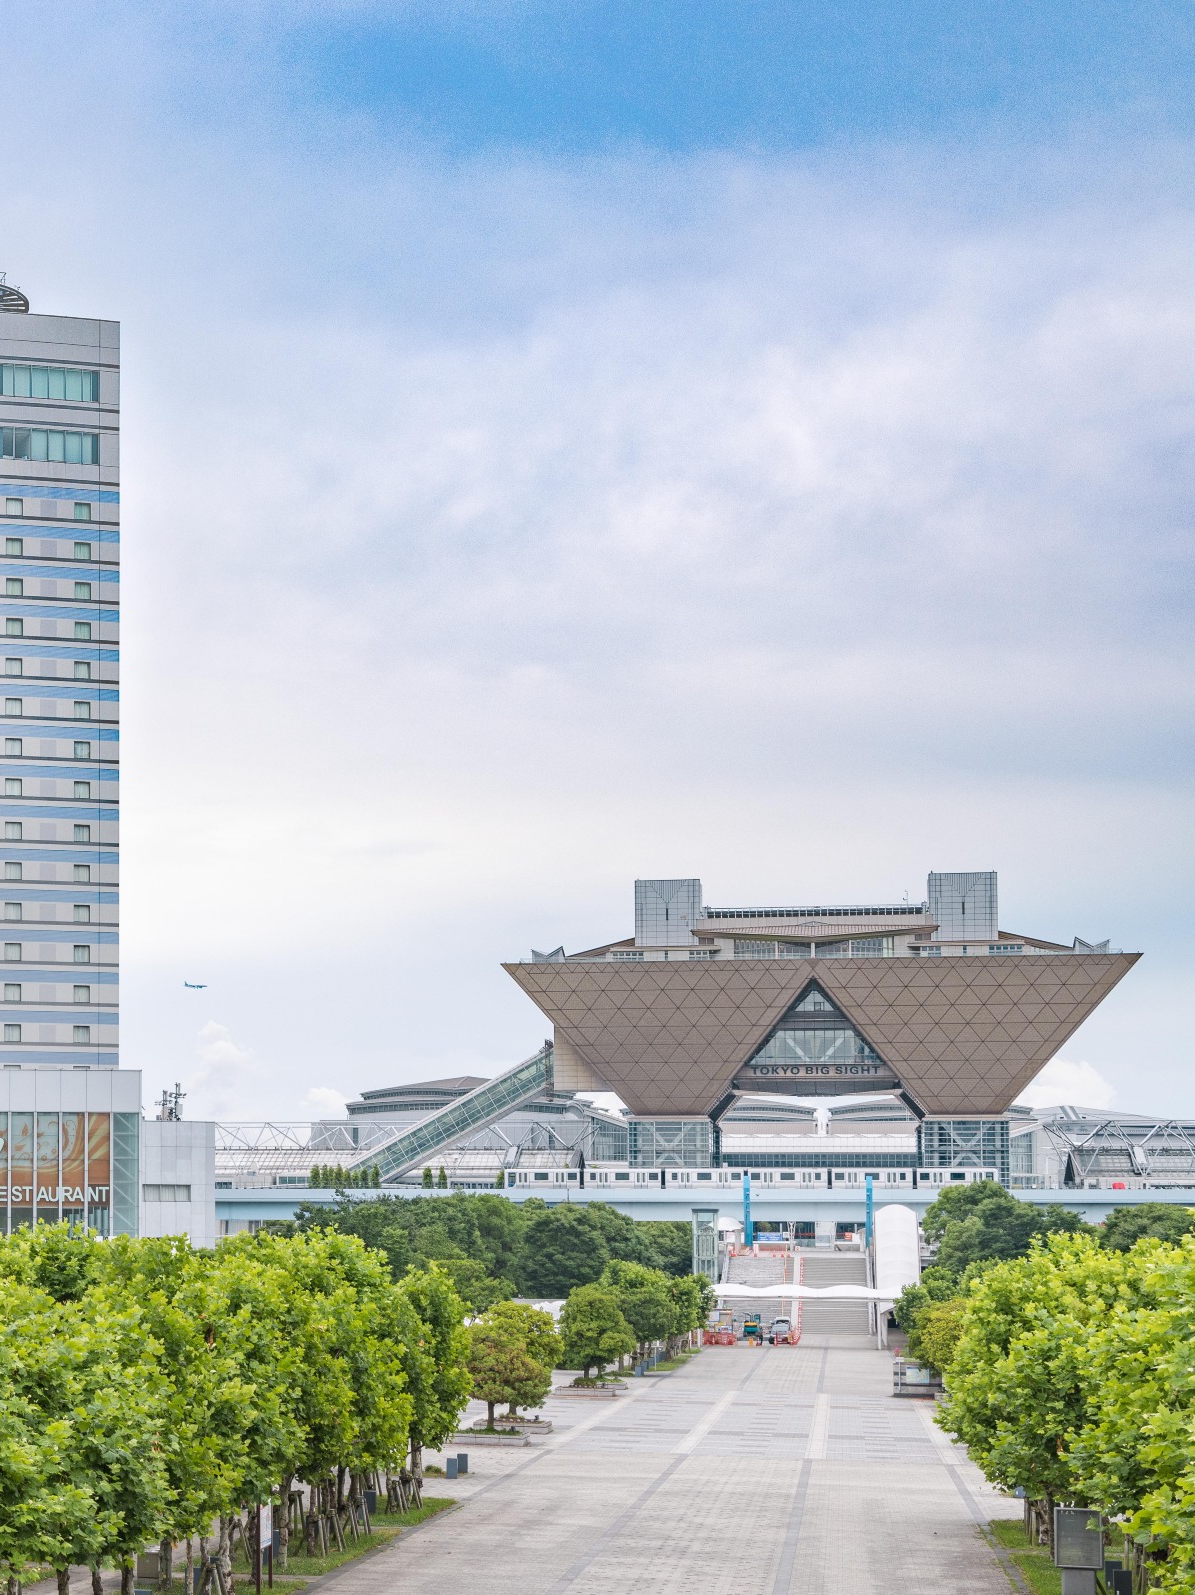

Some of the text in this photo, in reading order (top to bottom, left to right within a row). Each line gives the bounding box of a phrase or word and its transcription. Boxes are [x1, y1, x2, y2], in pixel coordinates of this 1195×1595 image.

[751, 1066, 880, 1075] TOKYO BIG SIGHT
